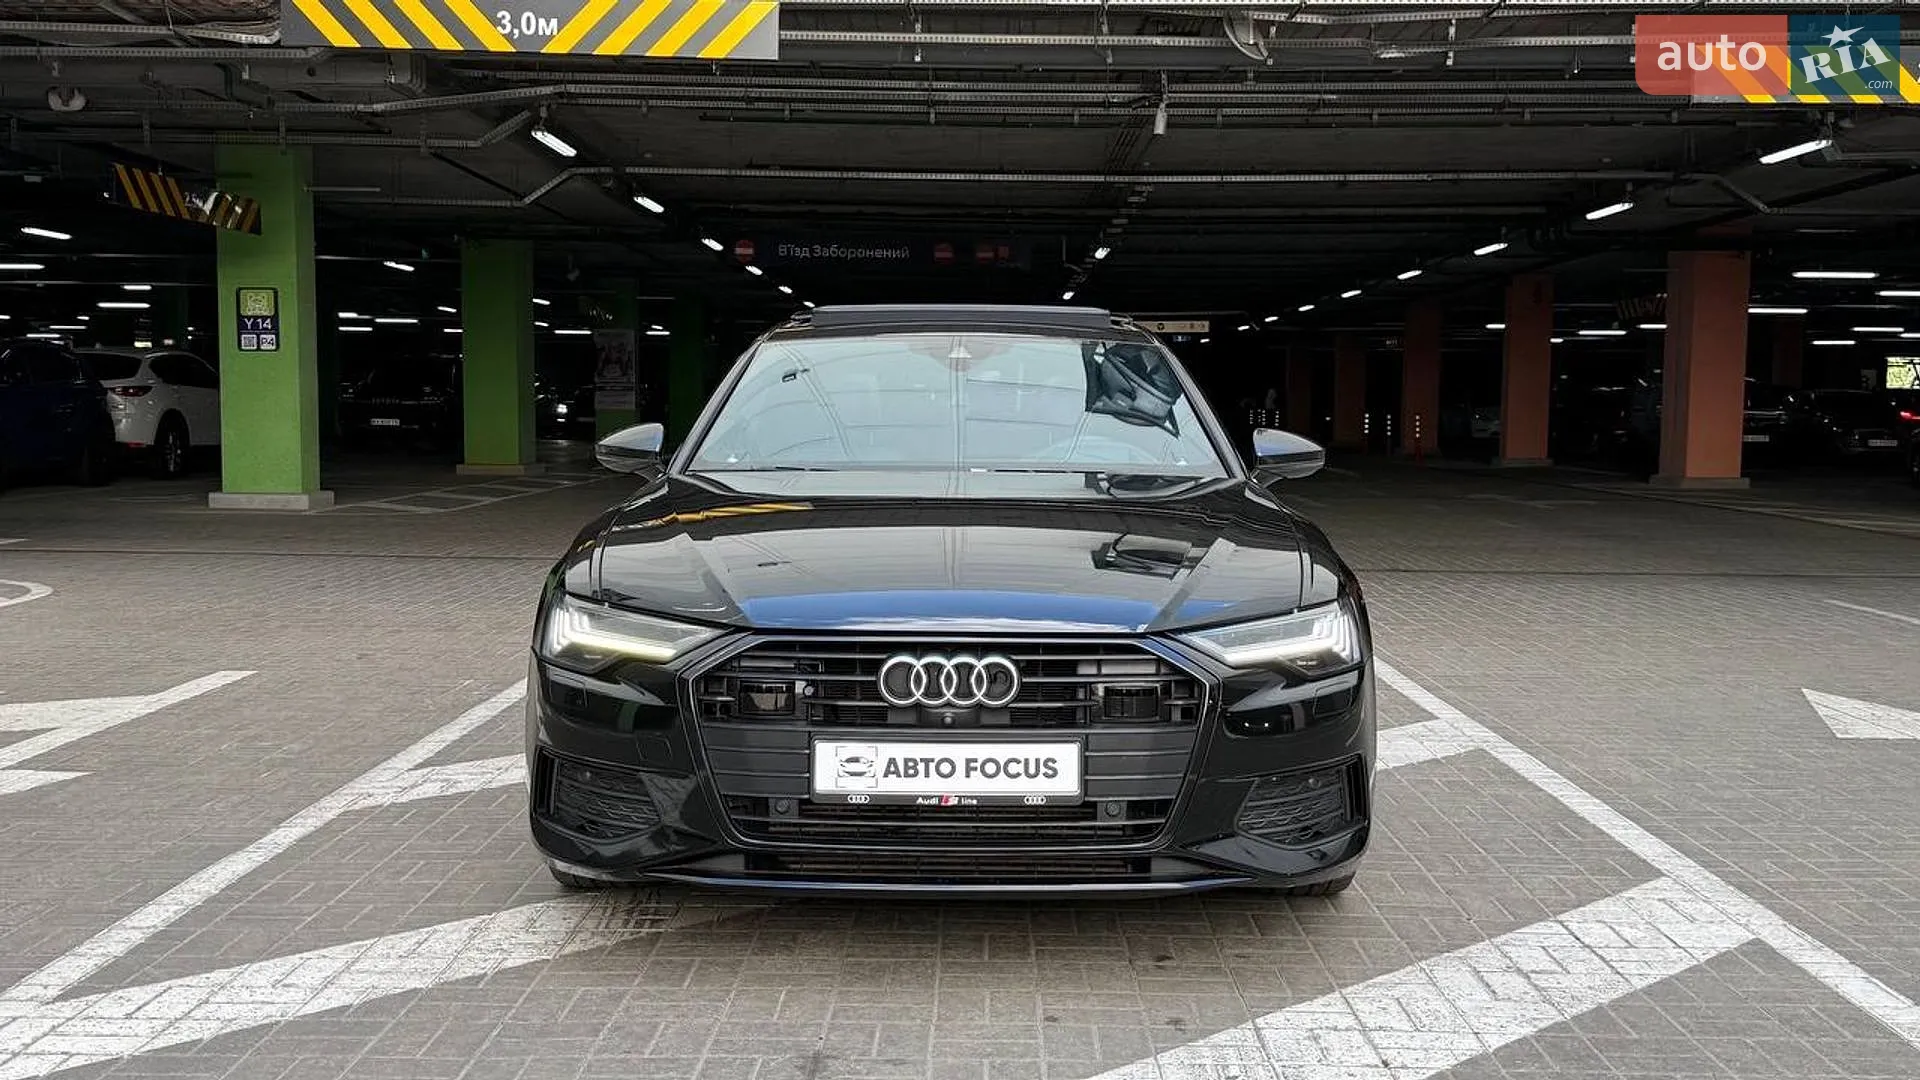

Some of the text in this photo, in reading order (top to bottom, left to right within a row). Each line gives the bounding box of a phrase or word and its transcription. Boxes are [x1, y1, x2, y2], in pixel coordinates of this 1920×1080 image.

[496, 10, 558, 39] 3,0м
[812, 244, 910, 261] Заборонений
[244, 318, 272, 330] Y 14
[964, 757, 1059, 780] FOCUS
[916, 796, 939, 805] Audi
[961, 796, 978, 805] line
